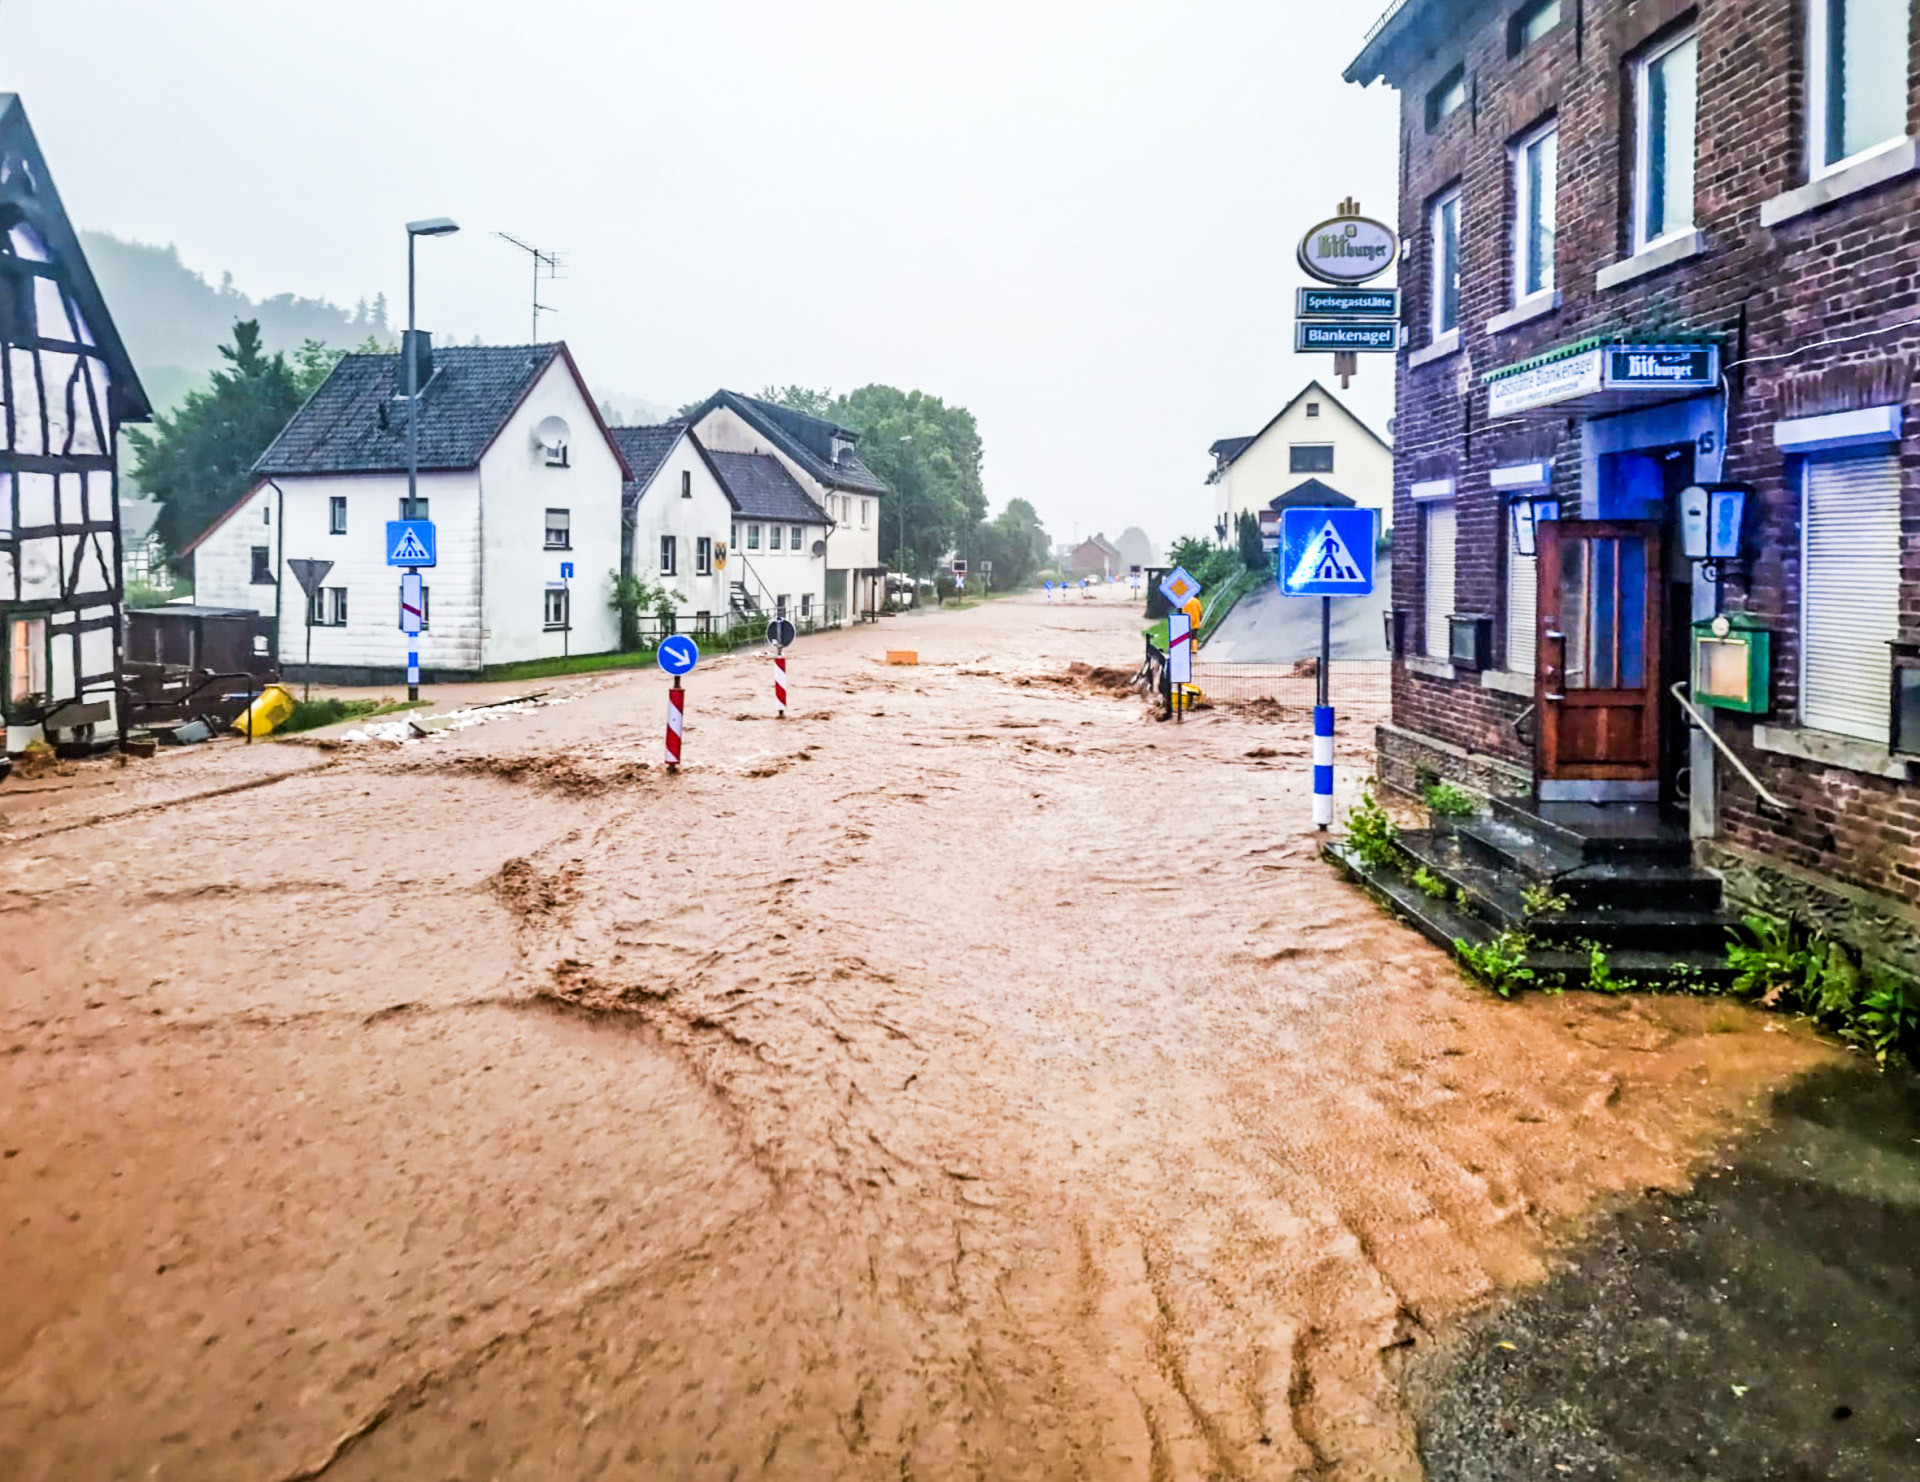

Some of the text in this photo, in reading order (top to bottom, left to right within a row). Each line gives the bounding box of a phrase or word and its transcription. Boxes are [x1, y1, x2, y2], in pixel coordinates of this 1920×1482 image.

[1317, 235, 1387, 262] Bitburger
[1308, 296, 1392, 309] Speisegaststätte
[1308, 329, 1391, 345] Blankenagel
[1628, 355, 1694, 380] Bitburger
